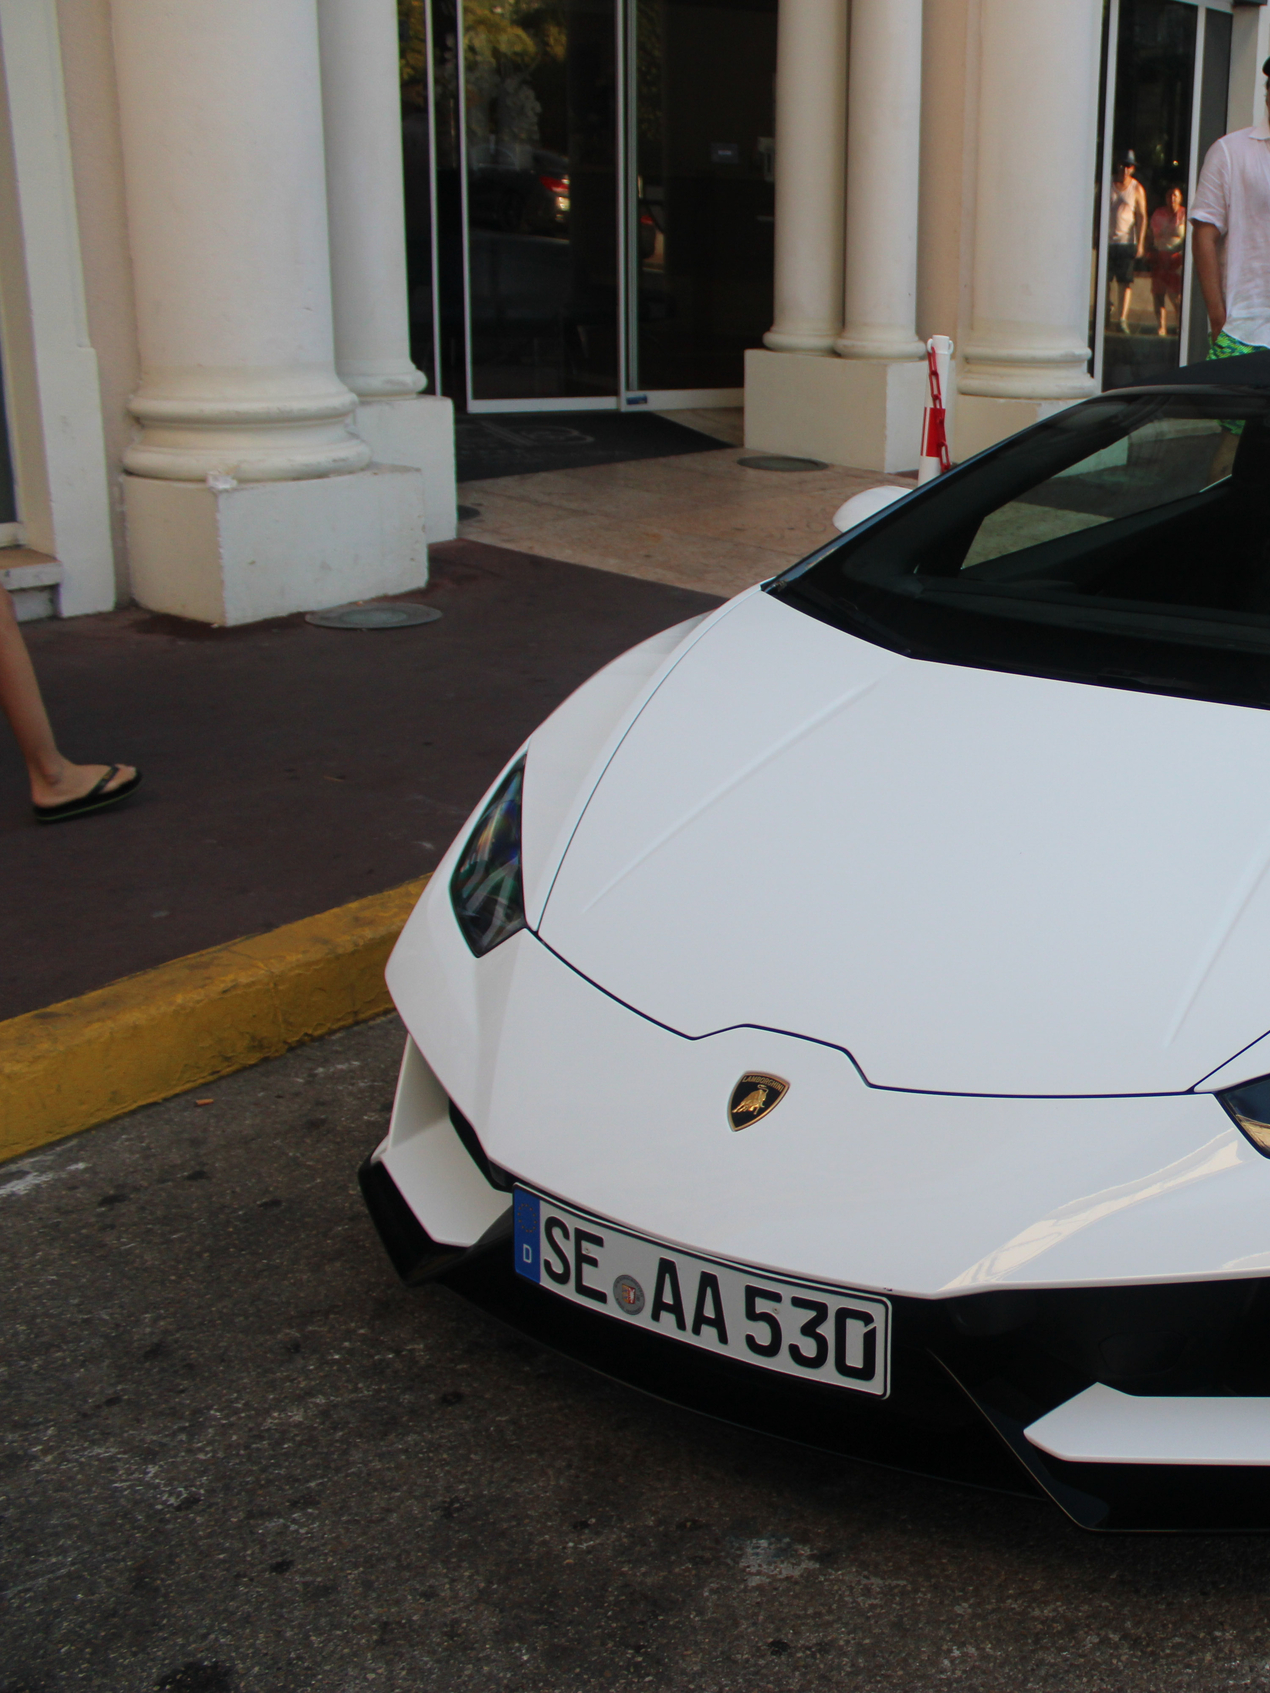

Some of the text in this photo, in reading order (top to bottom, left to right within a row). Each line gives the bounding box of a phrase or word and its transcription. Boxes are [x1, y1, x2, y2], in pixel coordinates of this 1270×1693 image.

[741, 1075, 785, 1093] LAMBORGHINI
[523, 1244, 532, 1263] D
[544, 1216, 607, 1304] SE
[651, 1257, 729, 1345] AA
[744, 1284, 877, 1381] 530
